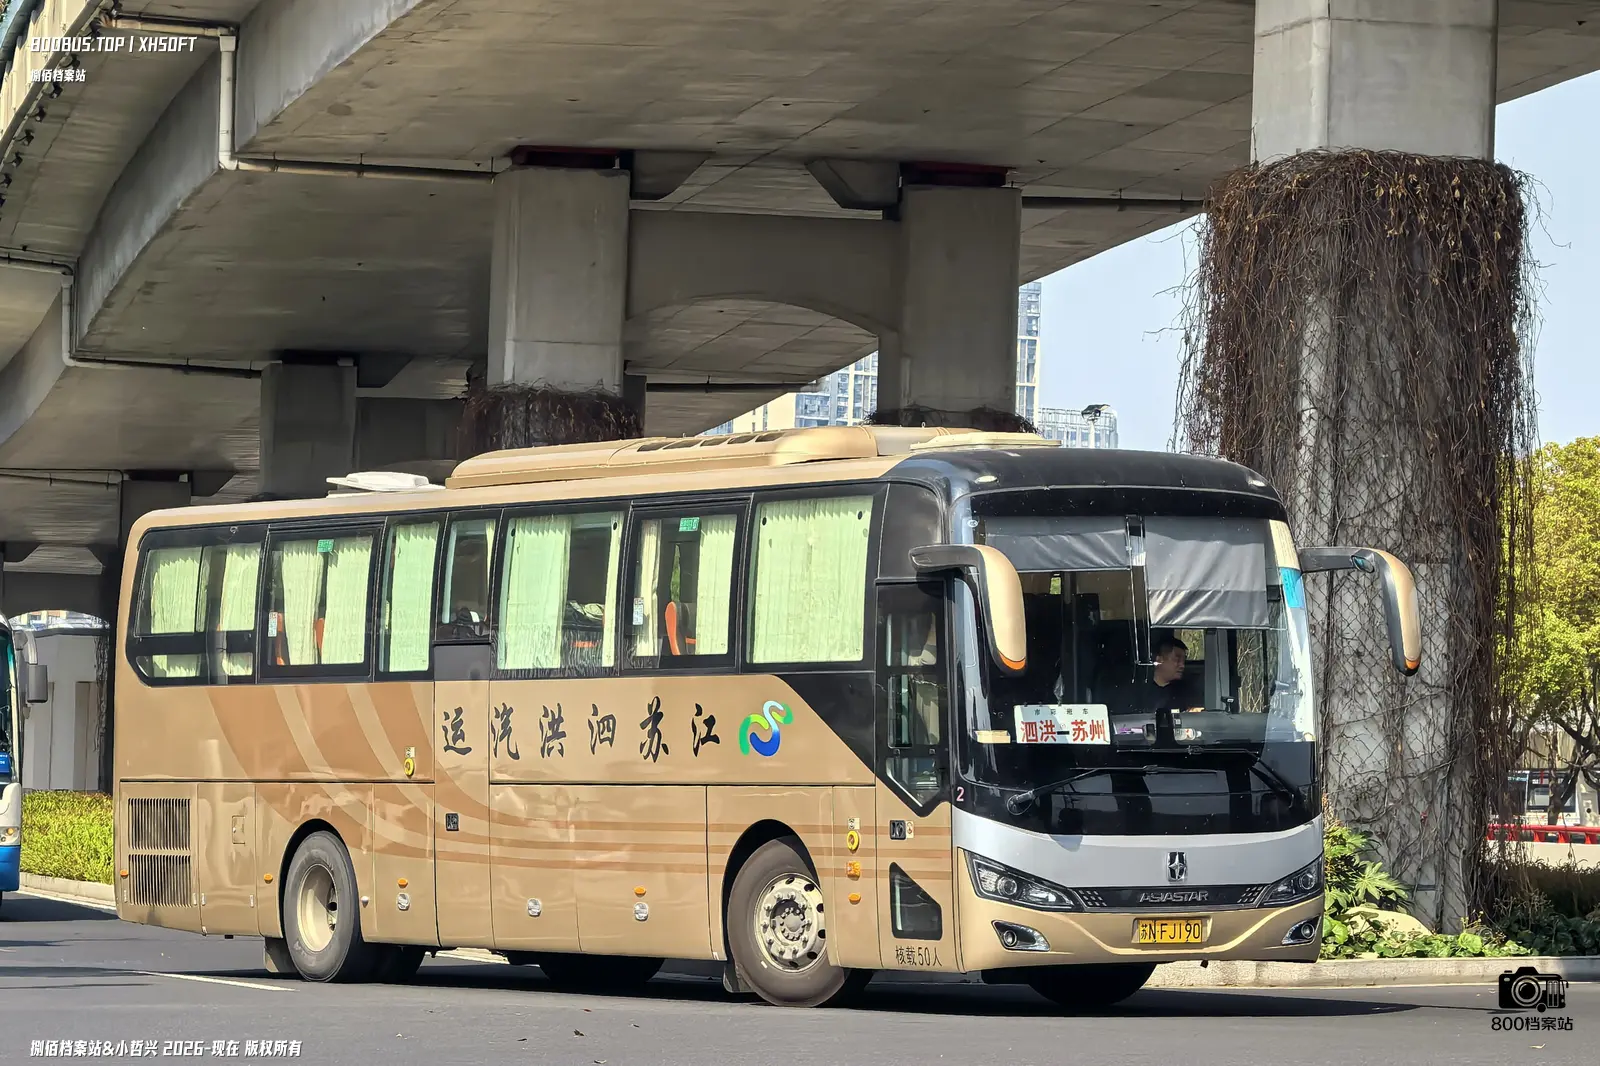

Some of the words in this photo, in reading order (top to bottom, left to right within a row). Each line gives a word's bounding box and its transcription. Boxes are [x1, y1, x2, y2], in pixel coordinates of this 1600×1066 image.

[956, 786, 965, 802] 2
[1139, 889, 1209, 903] ASIASTAR
[895, 945, 943, 968] 核载50人
